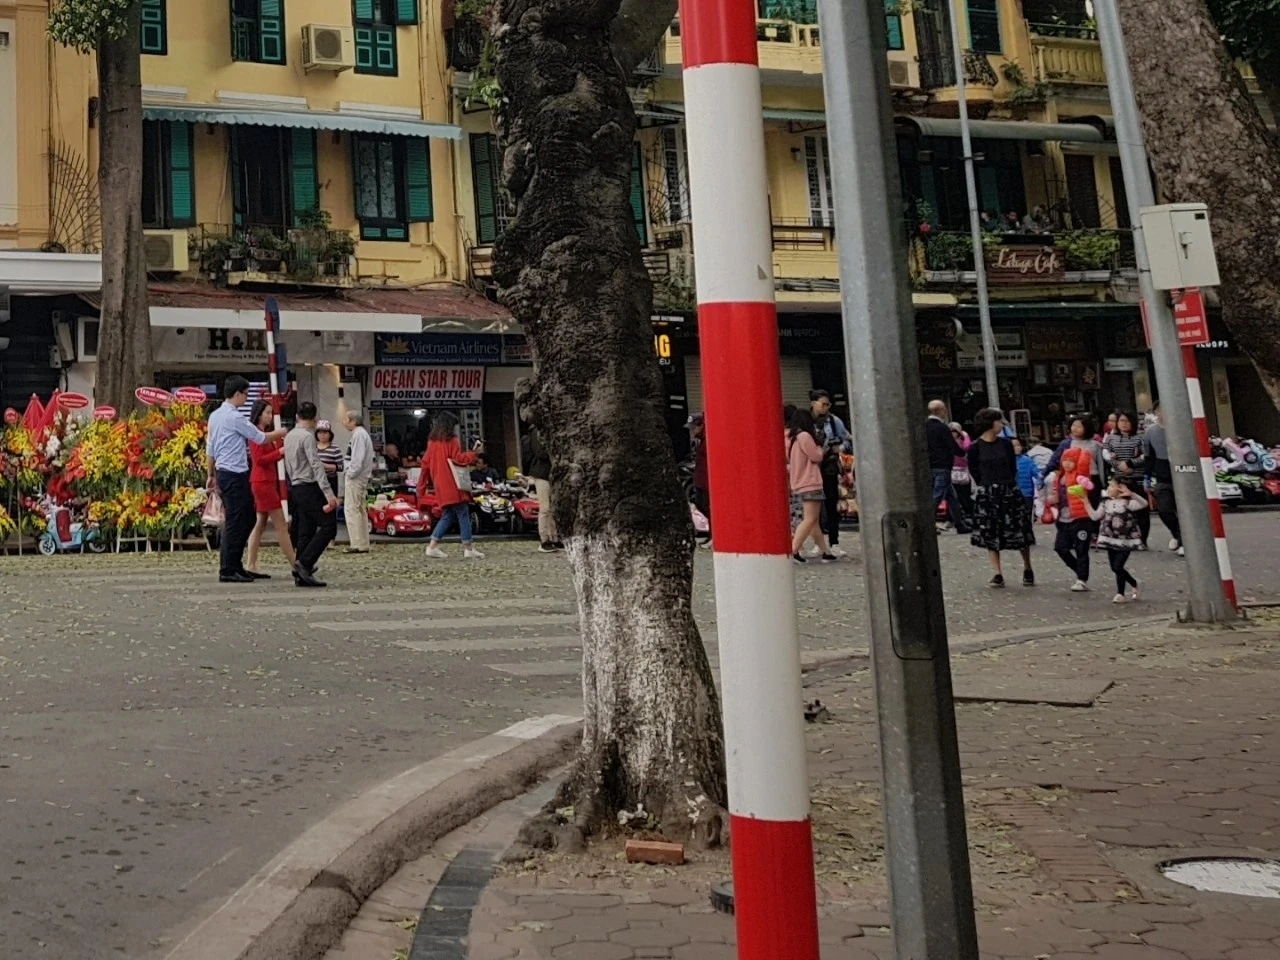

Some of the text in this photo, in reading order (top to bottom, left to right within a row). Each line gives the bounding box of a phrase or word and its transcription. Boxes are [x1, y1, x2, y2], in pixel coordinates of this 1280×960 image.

[412, 340, 458, 354] Vietnam
[458, 340, 500, 354] Airlines
[374, 369, 482, 389] OCEAN STAR TOUR
[381, 390, 472, 399] BOOKING OFFICE
